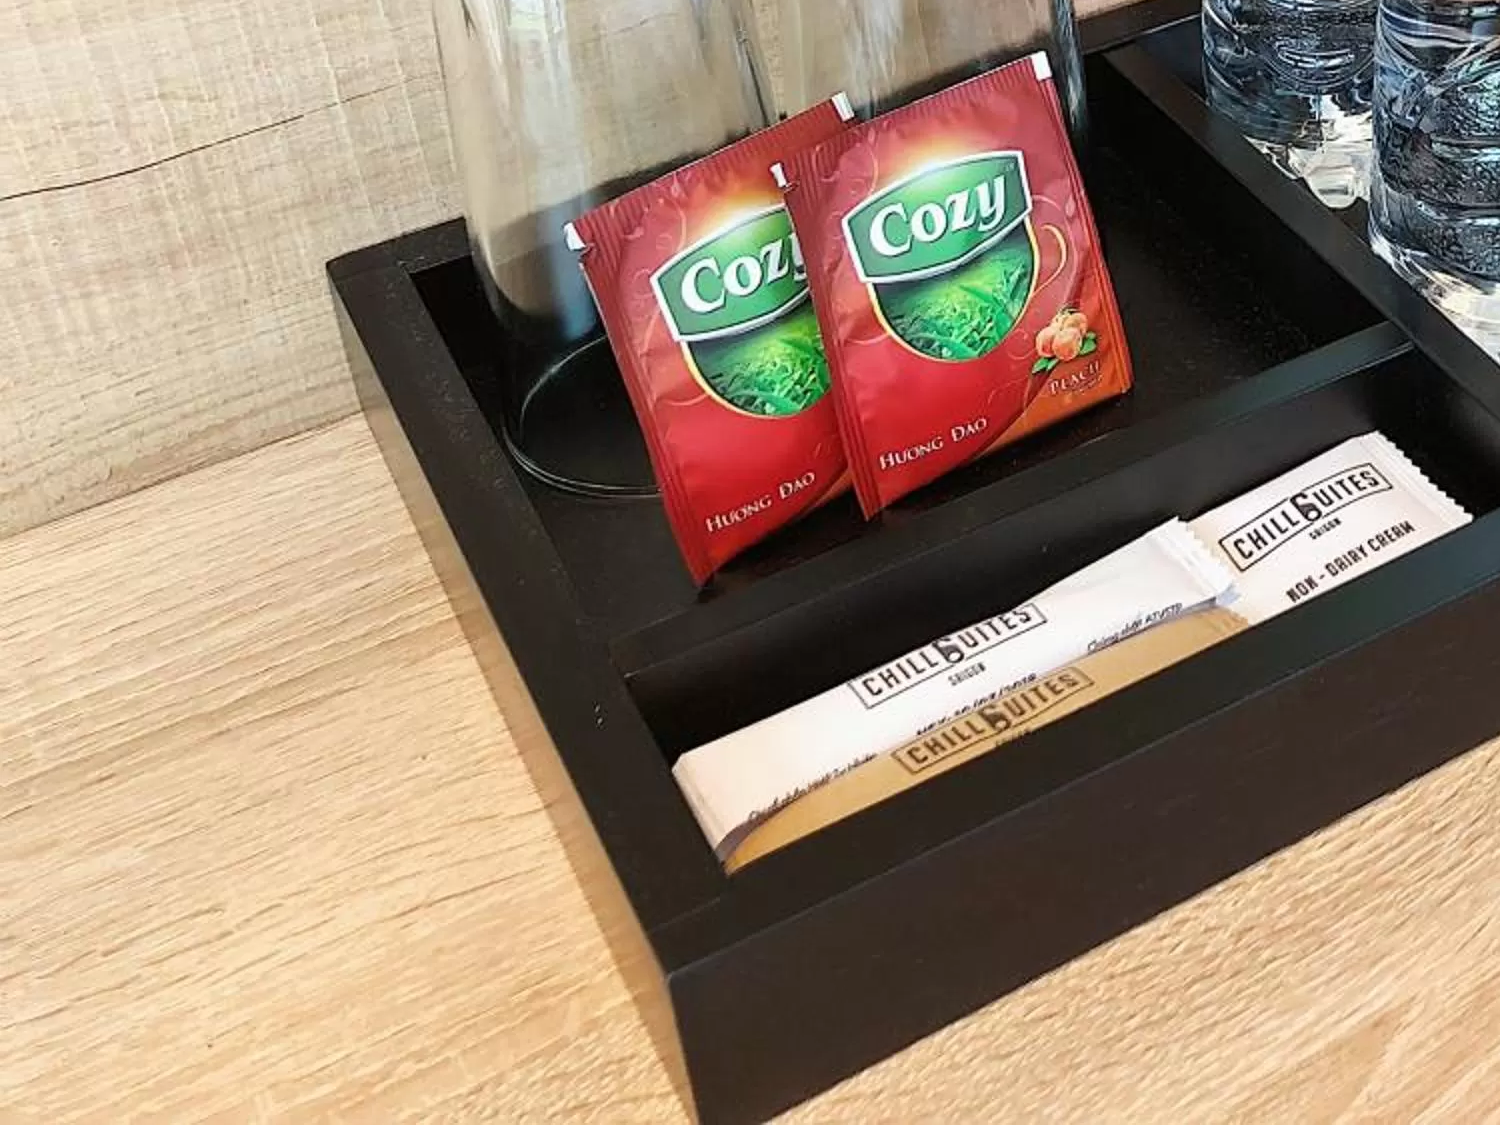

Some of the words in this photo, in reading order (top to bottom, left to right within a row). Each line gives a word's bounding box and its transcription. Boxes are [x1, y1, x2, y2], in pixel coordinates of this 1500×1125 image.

[868, 174, 1007, 258] Cozy
[1325, 544, 1369, 578] DAIRY
[1366, 520, 1416, 553] CREAM
